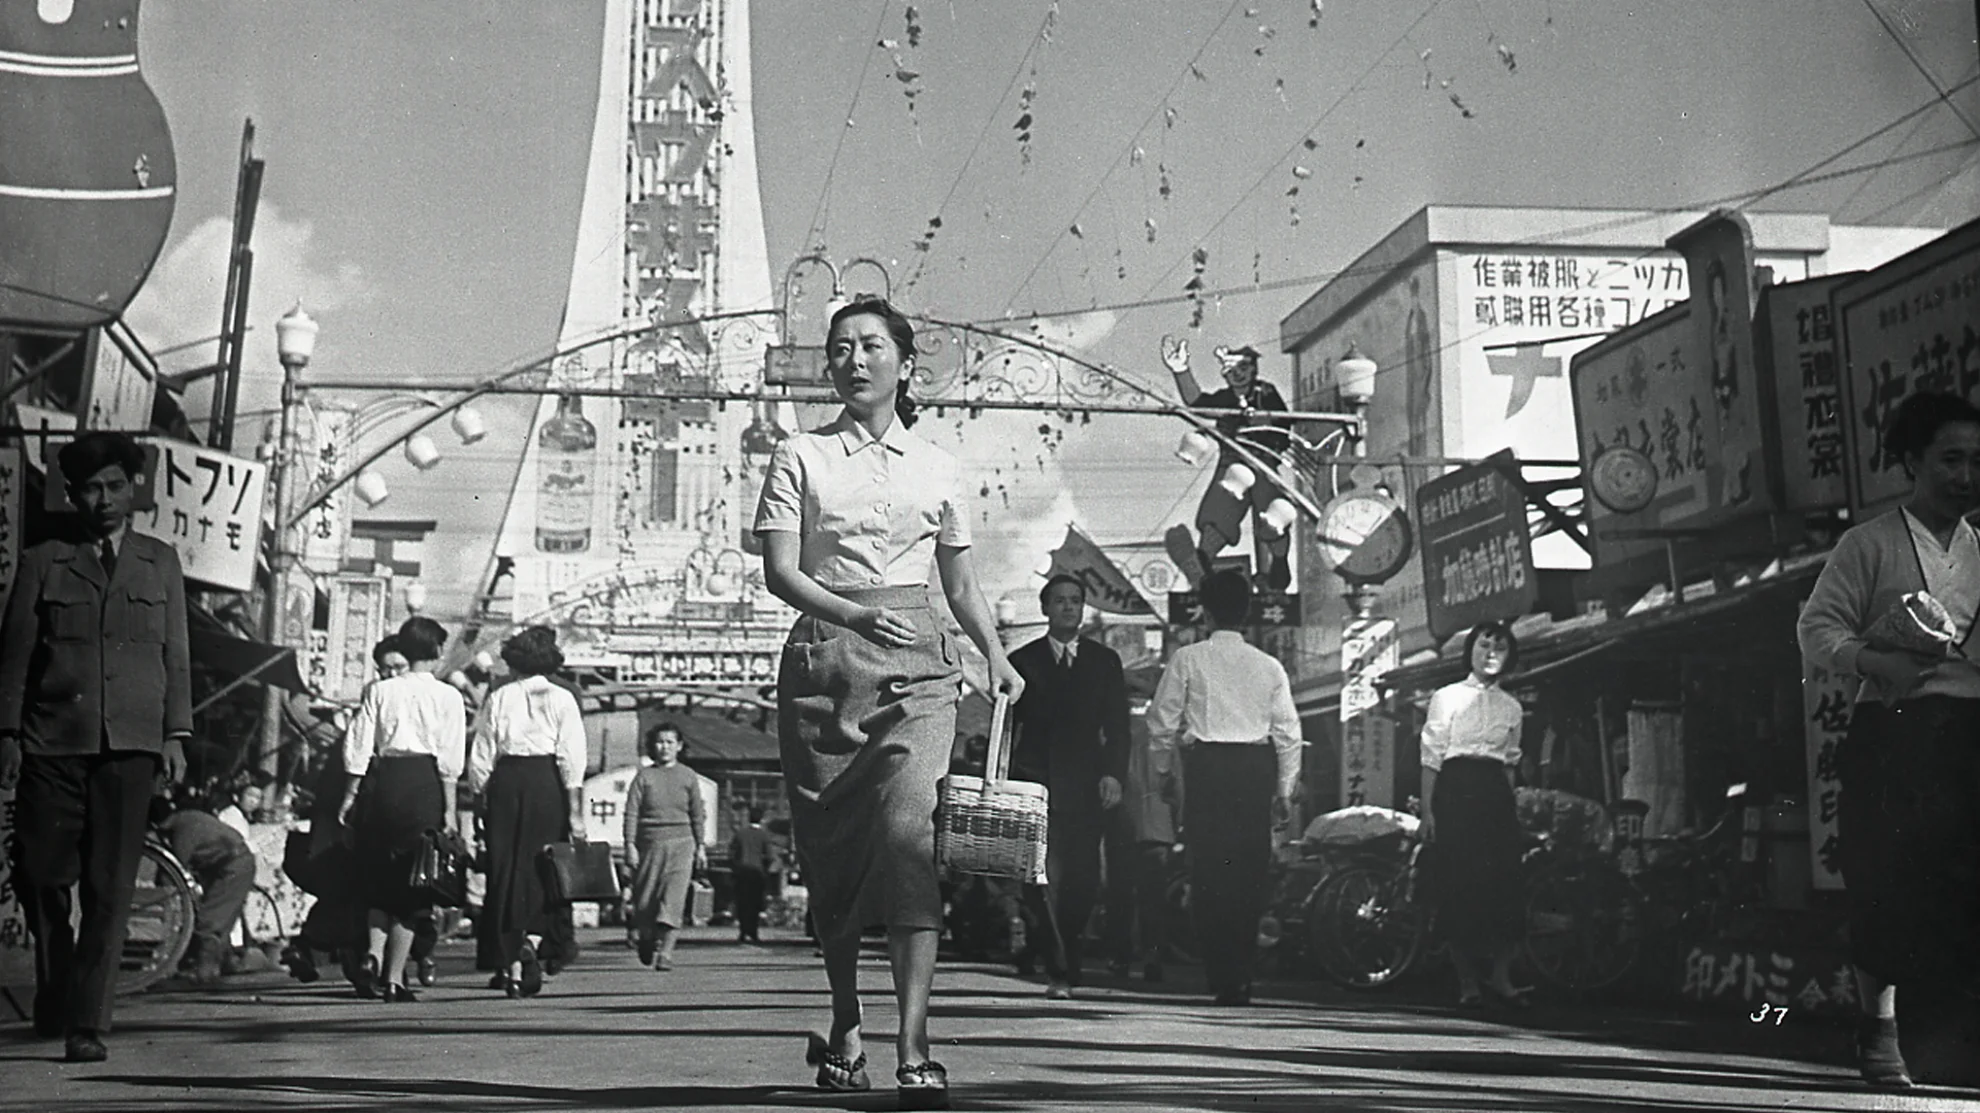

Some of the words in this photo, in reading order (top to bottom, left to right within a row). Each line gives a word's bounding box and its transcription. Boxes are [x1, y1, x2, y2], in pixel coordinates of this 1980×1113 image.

[625, 0, 721, 522] スウヰスキー
